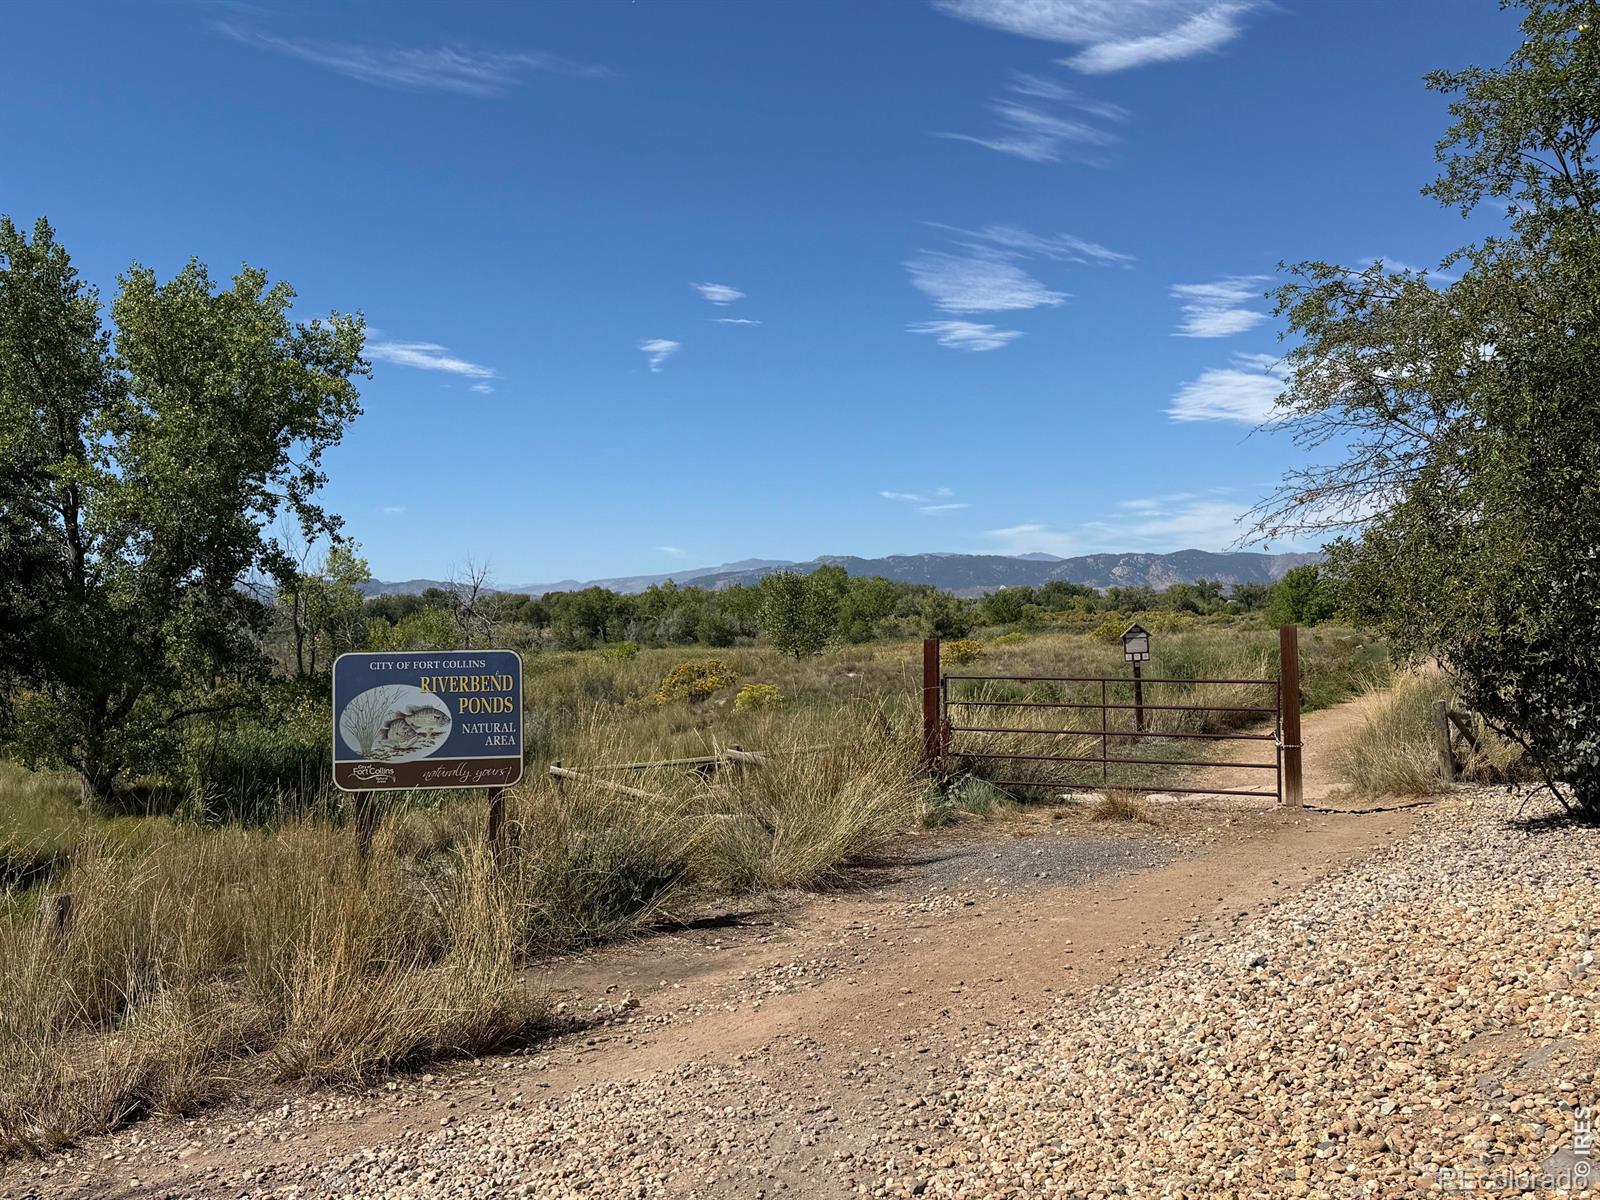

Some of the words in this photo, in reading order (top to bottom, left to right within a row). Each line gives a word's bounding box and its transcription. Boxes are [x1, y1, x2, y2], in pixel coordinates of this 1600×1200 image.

[369, 661, 394, 670] CITY
[396, 661, 410, 670] OF
[413, 660, 440, 670] FORT
[442, 659, 486, 669] COLLINS
[420, 674, 513, 694] RIVERBEND
[458, 696, 513, 714] PONDS
[462, 722, 516, 734] NATURAL
[485, 735, 516, 746] AREA
[353, 767, 368, 775] Fort
[369, 767, 394, 775] Collins
[422, 761, 472, 783] naturally
